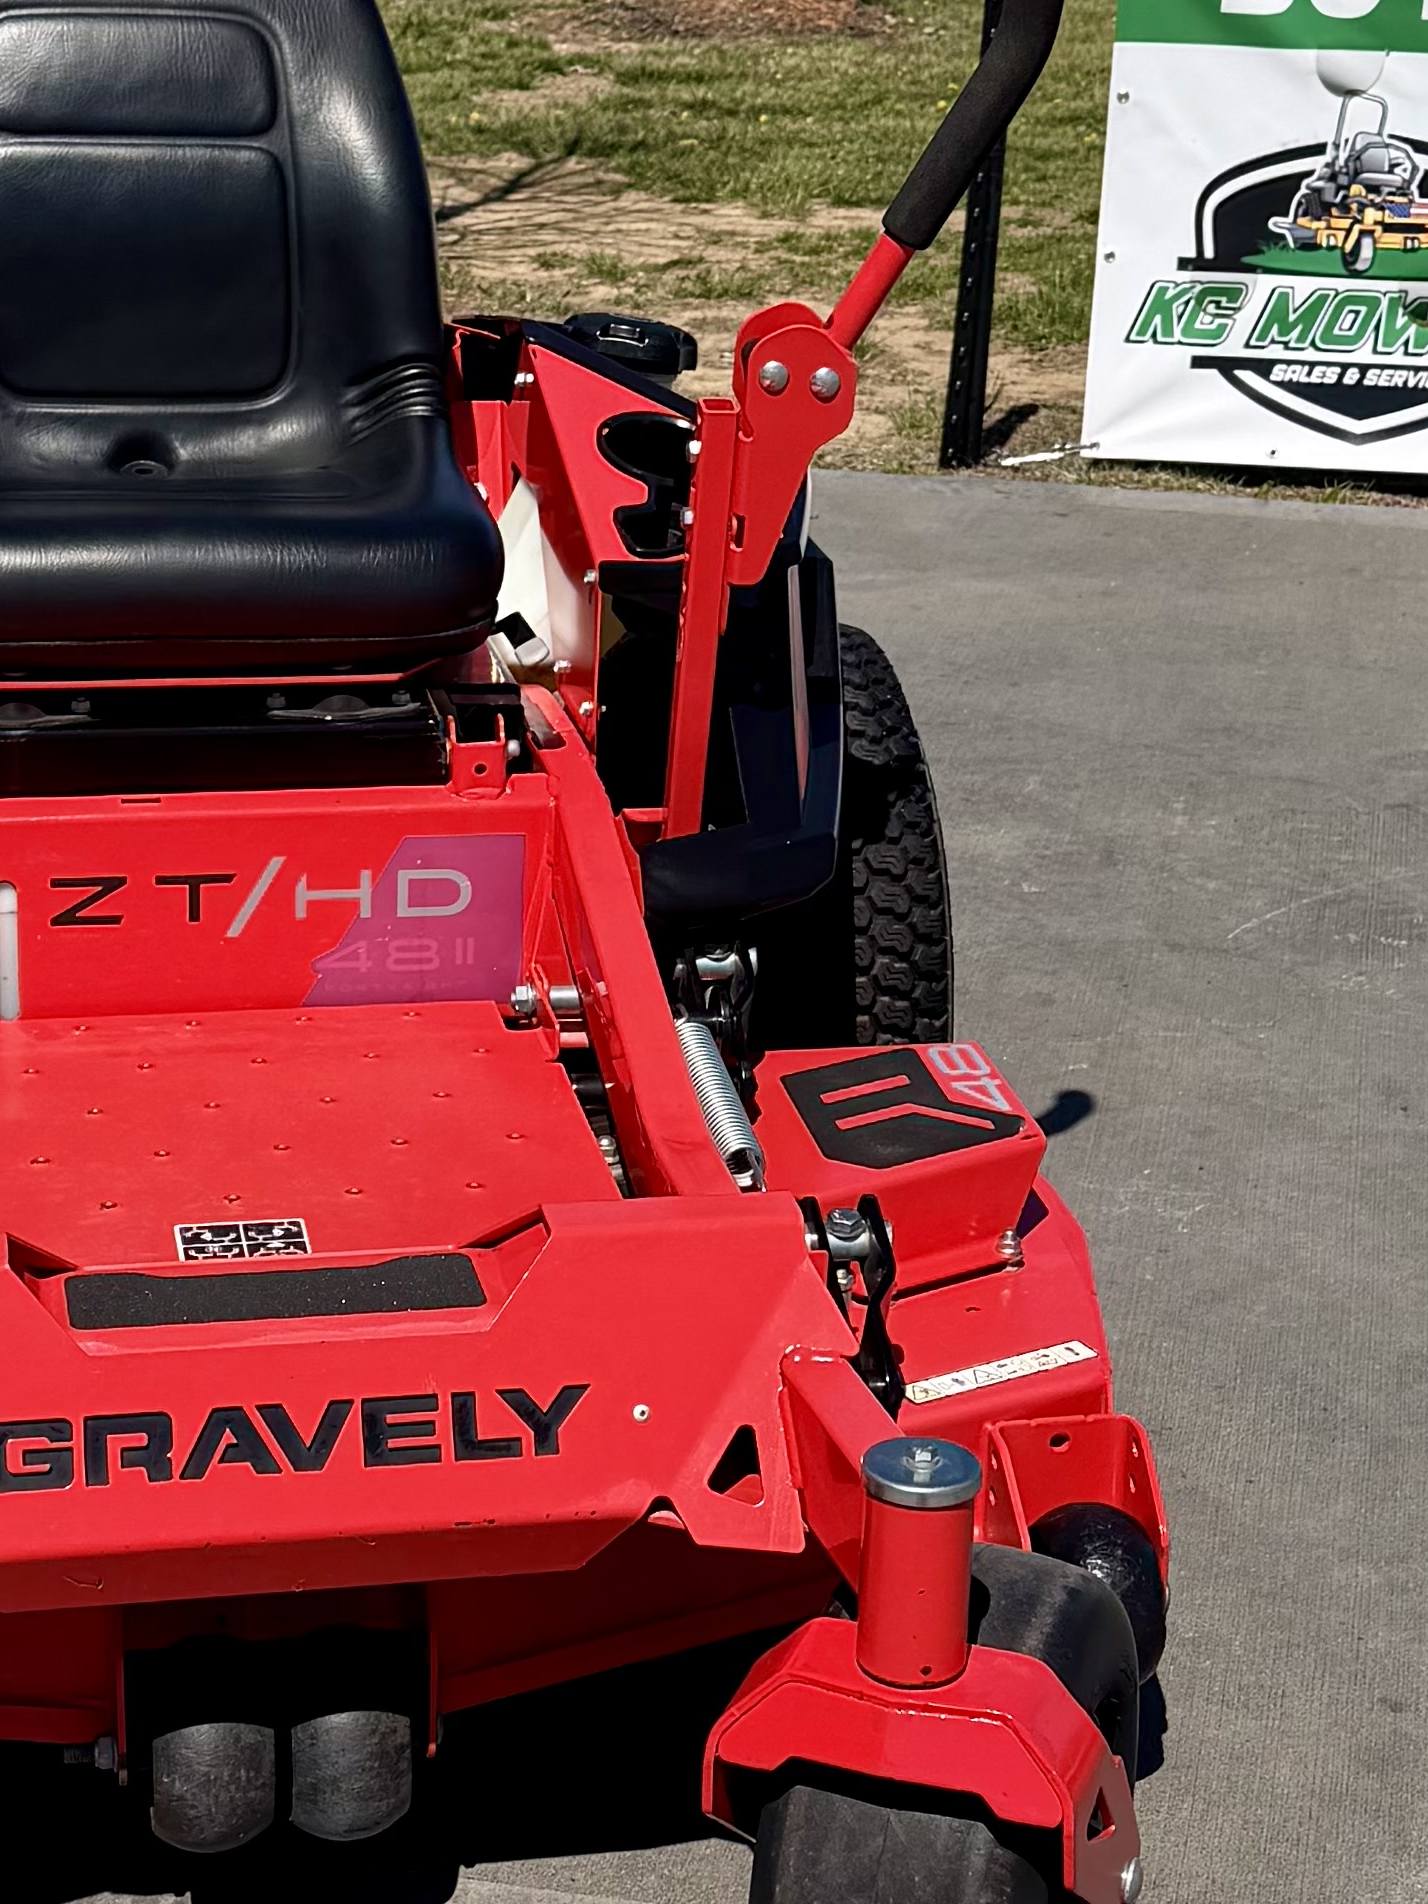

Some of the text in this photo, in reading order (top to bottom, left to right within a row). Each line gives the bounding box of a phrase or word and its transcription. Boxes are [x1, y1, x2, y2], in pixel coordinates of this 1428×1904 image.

[1124, 280, 1249, 346] KC
[1270, 364, 1339, 385] SALES
[1343, 366, 1360, 385] &
[928, 1044, 1013, 1111] 48
